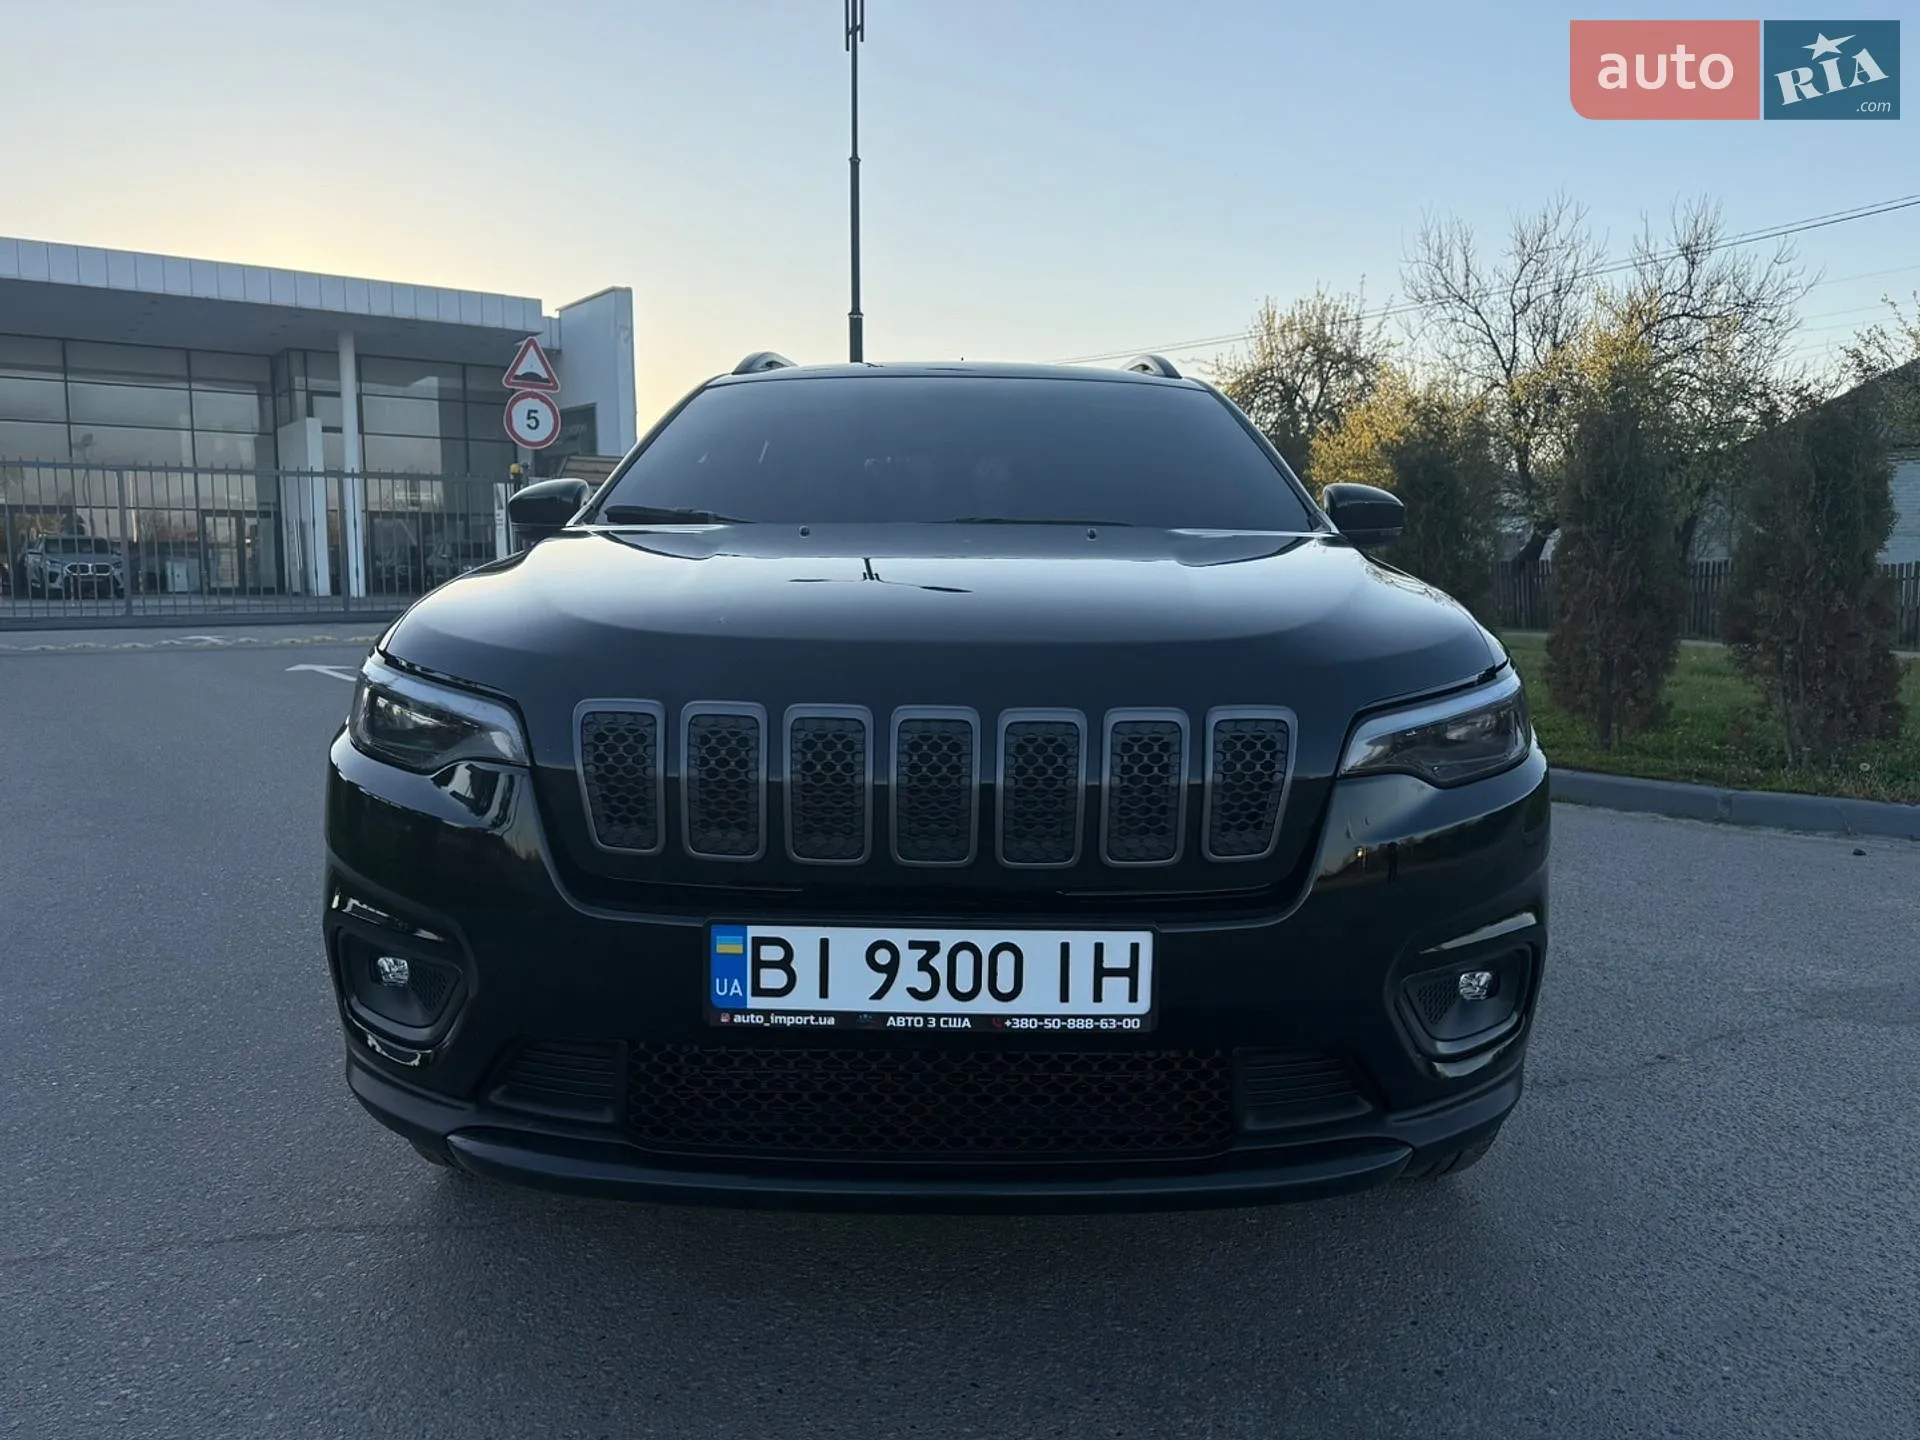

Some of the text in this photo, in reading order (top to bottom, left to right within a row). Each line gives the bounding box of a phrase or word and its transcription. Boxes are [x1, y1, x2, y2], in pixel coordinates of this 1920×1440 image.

[526, 409, 540, 430] 5
[751, 936, 1140, 1003] BI 9300 IH
[716, 979, 742, 997] UA
[733, 1013, 835, 1027] auto_import.ua
[886, 1016, 924, 1028] АВТО
[940, 1017, 971, 1029] США
[1004, 1017, 1141, 1030] +380-50-888-63-00
